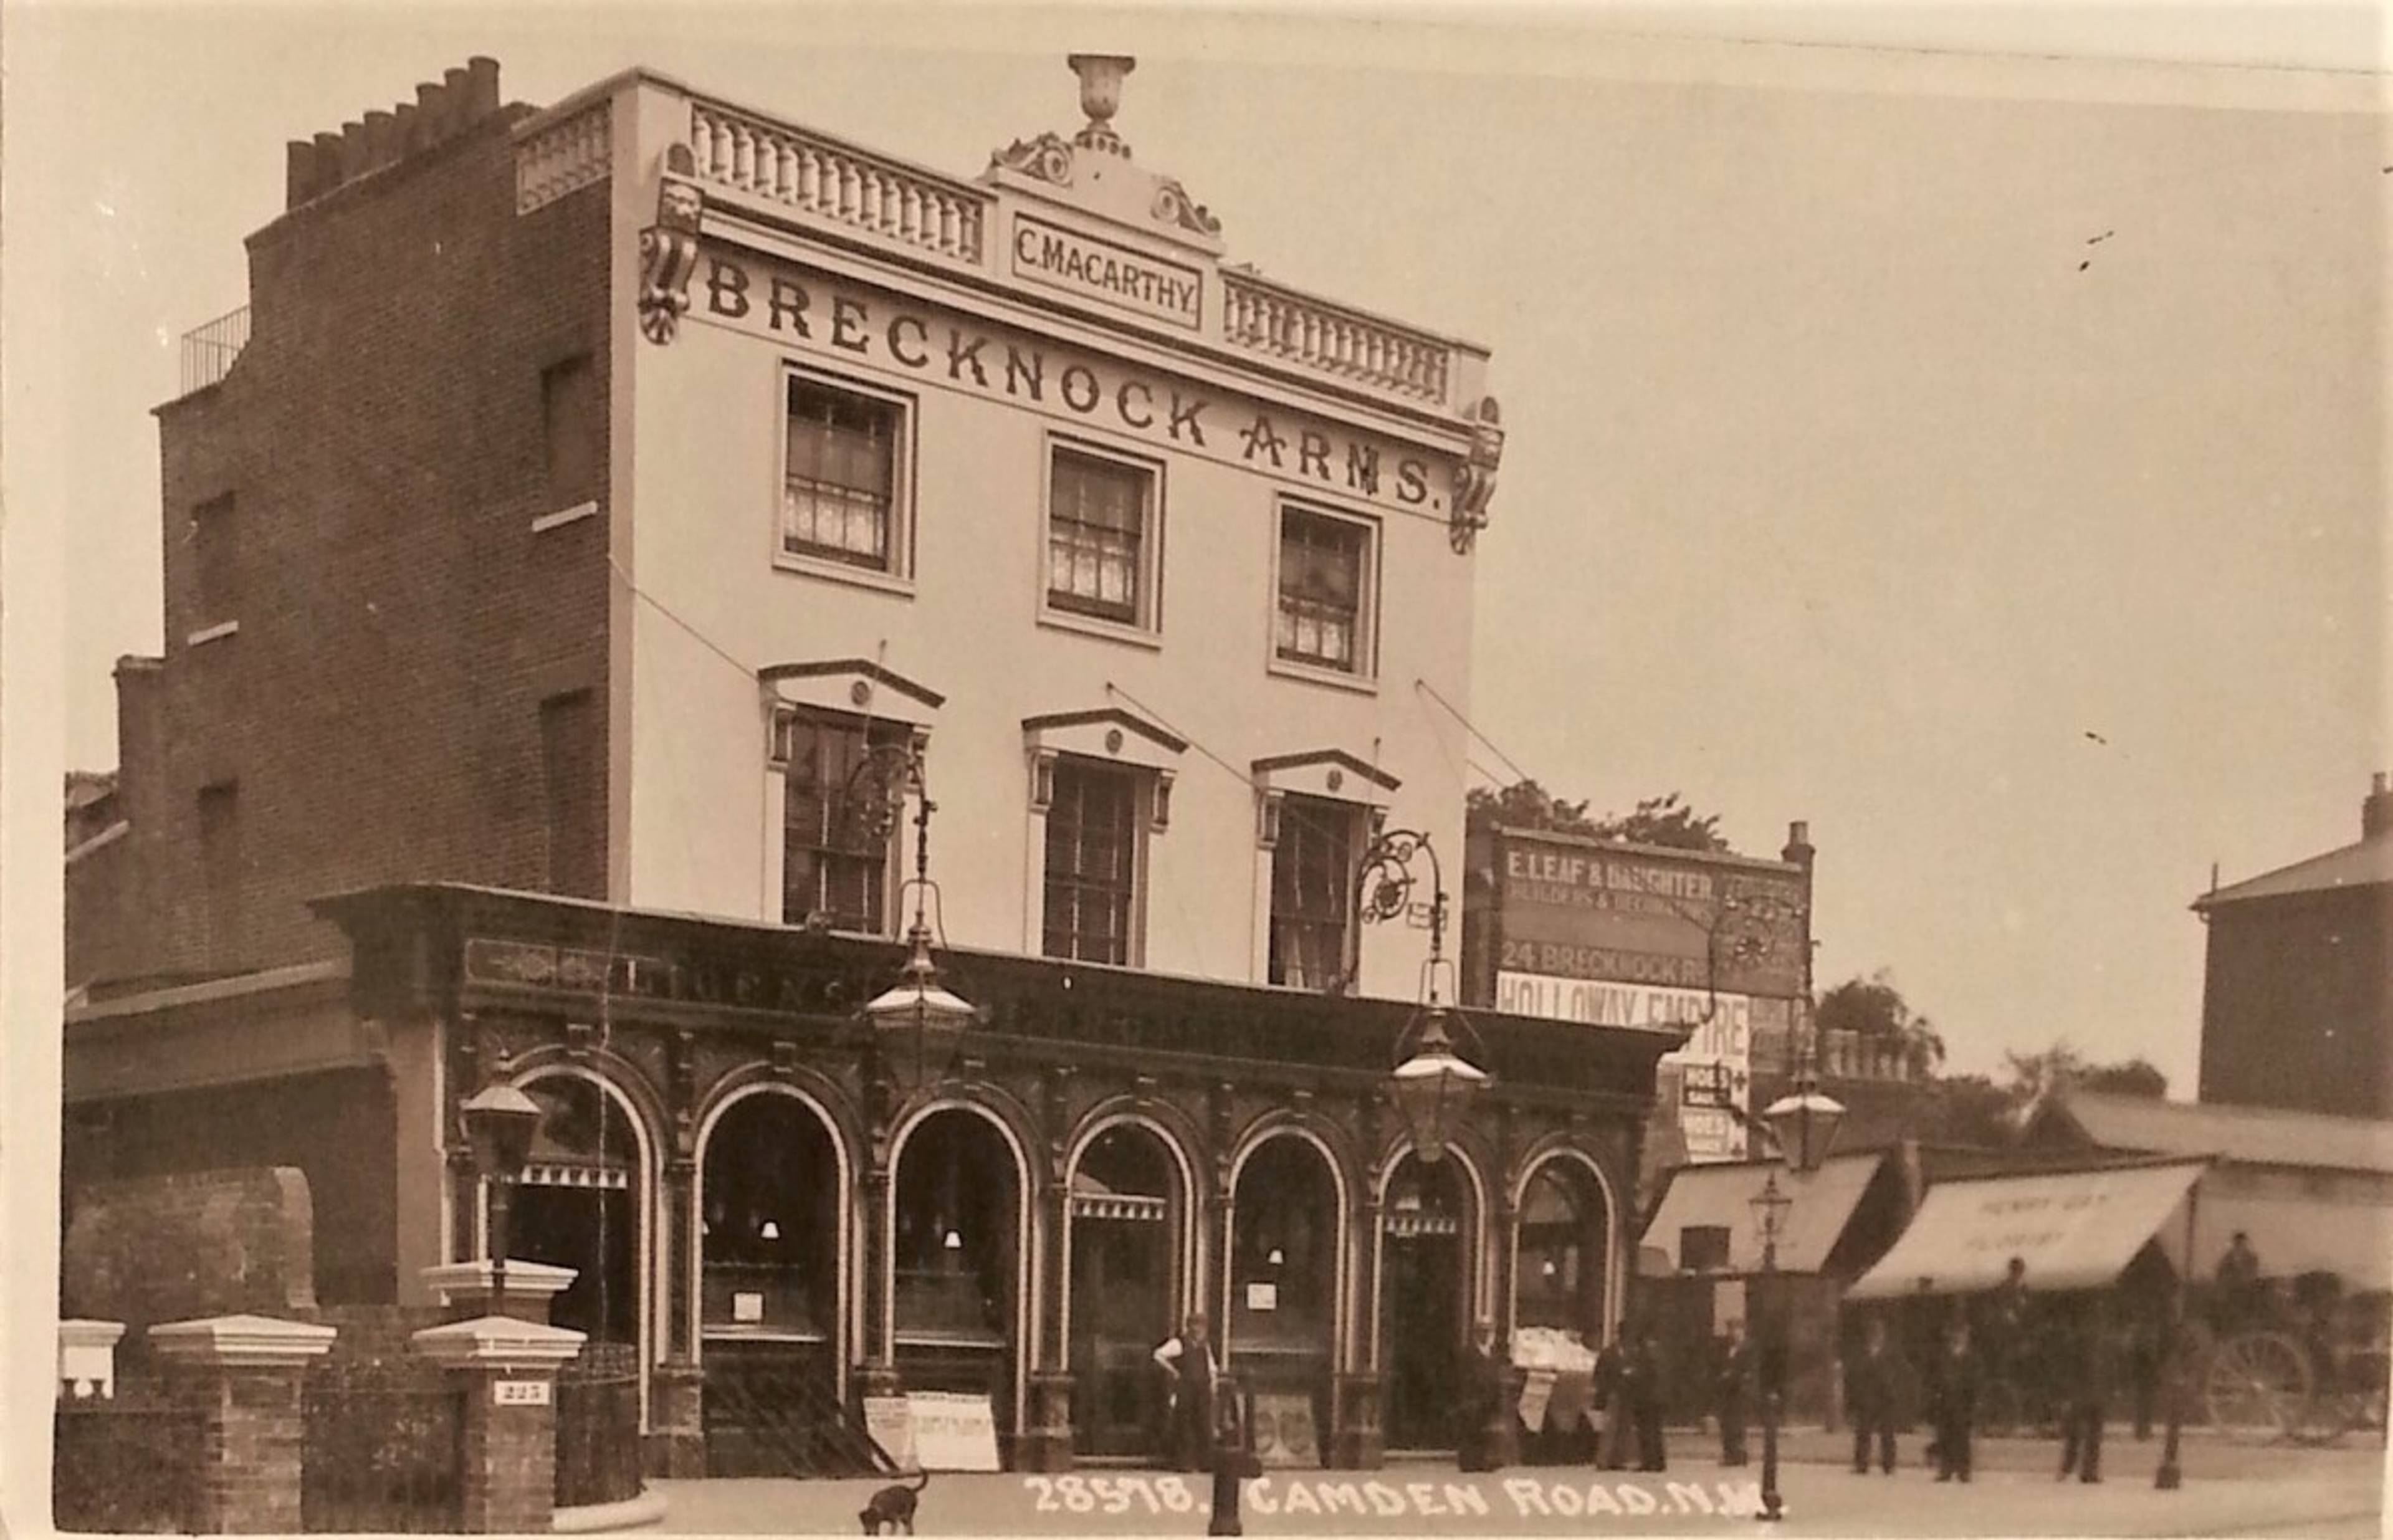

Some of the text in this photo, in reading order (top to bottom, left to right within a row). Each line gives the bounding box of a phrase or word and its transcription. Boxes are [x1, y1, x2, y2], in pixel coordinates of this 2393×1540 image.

[706, 259, 1439, 510] BRECKNOCK ARMS.
[1588, 861, 1603, 888] &
[1501, 940, 1536, 969] 24
